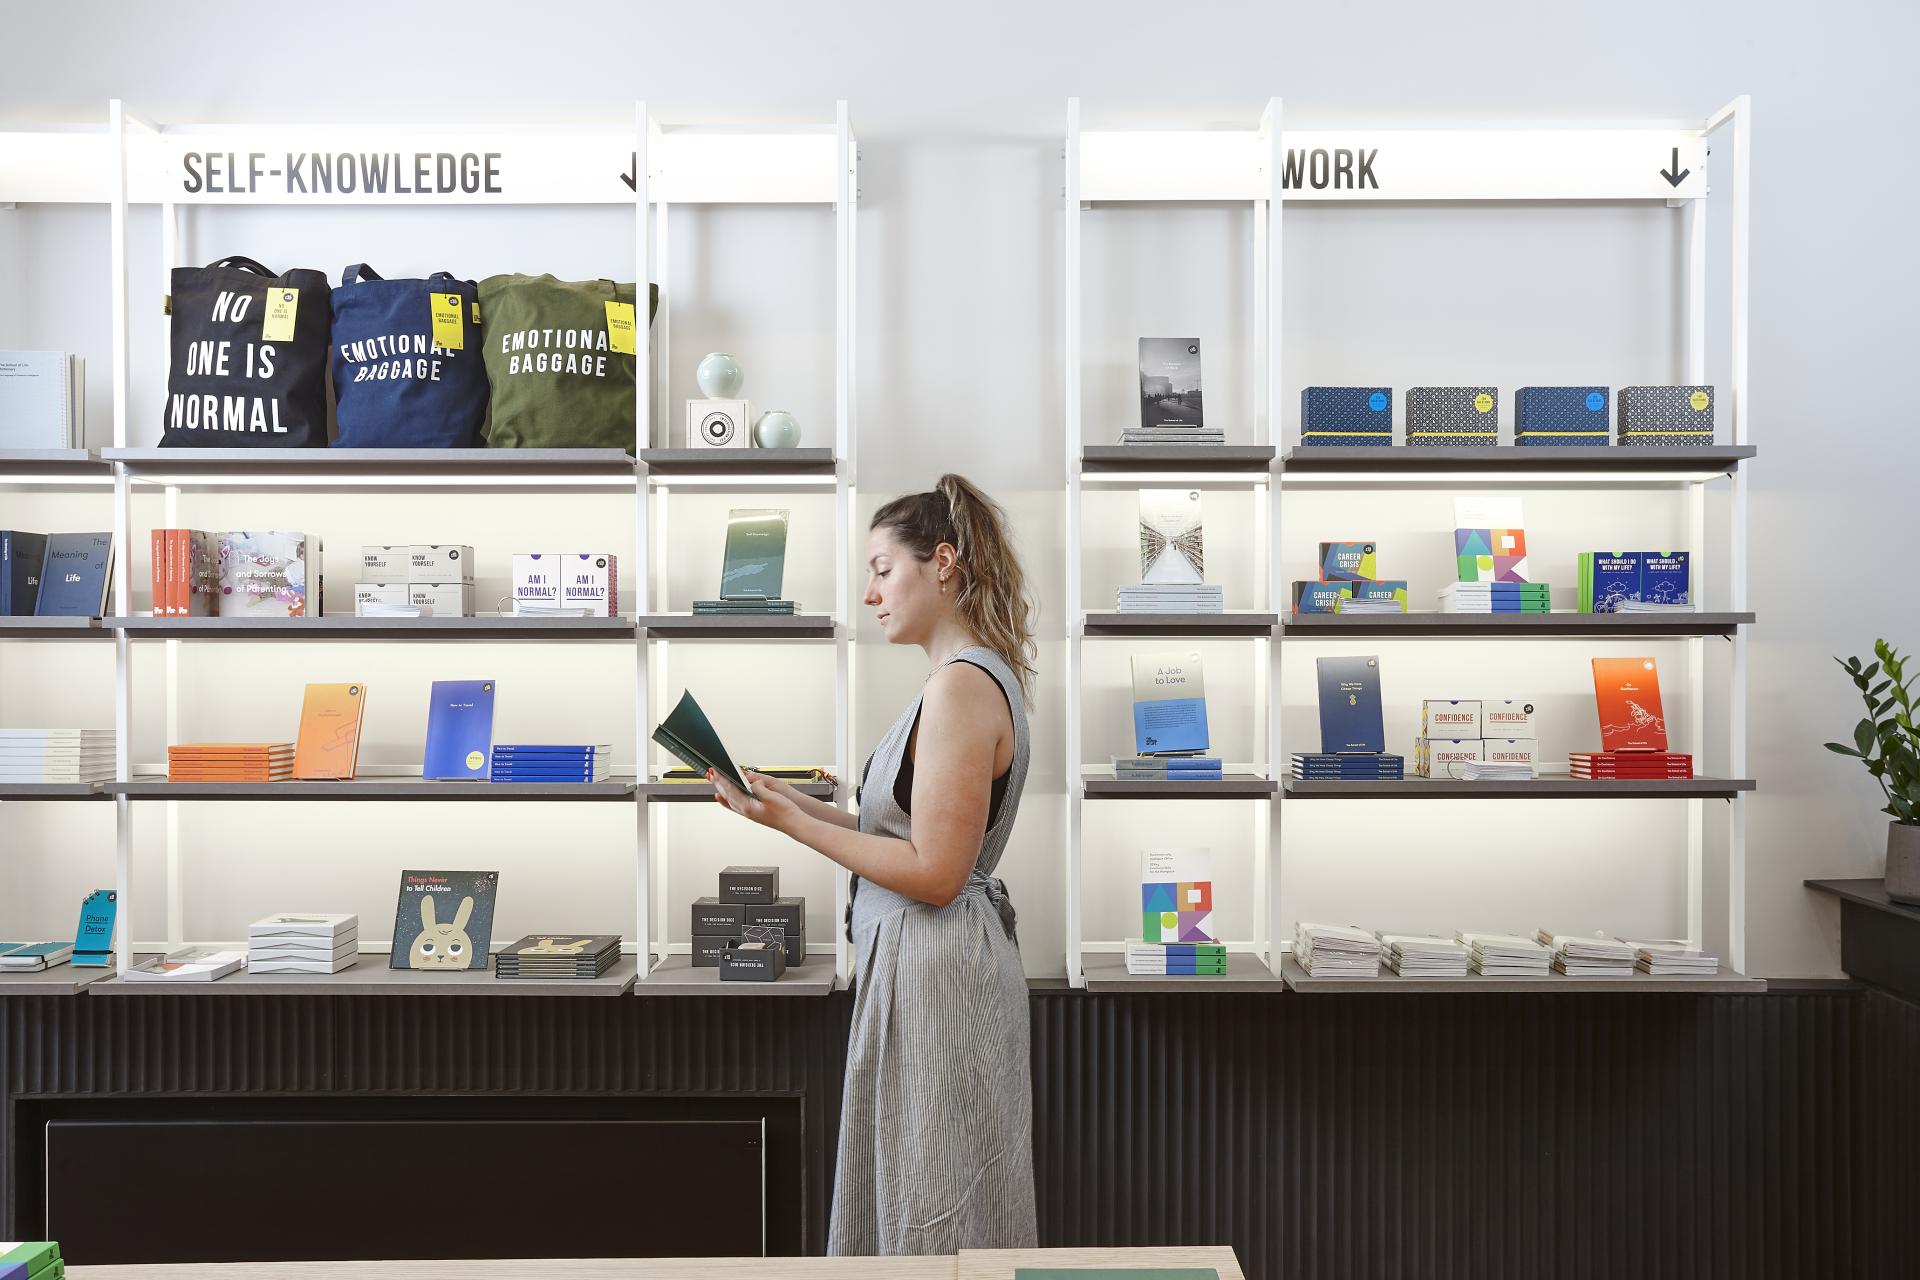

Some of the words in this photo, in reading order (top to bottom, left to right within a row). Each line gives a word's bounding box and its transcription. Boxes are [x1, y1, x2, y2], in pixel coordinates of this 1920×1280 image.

[183, 151, 502, 194] SELF-KNOWLEDGE
[1281, 148, 1379, 190] WORK
[211, 291, 253, 323] NO
[502, 329, 608, 354] EMOTIONA
[186, 340, 231, 376] ONE
[246, 343, 276, 379] IS
[508, 352, 607, 377] BAGGAGE
[353, 358, 442, 383] BAGGAGE
[170, 393, 288, 433] NORMAL
[93, 538, 107, 546] The
[52, 551, 88, 560] Meaning
[244, 555, 258, 563] The
[259, 555, 279, 565] Joys
[1337, 553, 1361, 561] CAREER
[95, 562, 104, 570] of
[65, 573, 81, 583] Life
[236, 570, 252, 578] and
[253, 570, 287, 578] Sorrows
[528, 574, 541, 585] AM
[576, 575, 589, 585] AM
[236, 585, 245, 593] of
[246, 585, 287, 595] Parenting
[517, 586, 557, 597] NORMAL?
[565, 587, 605, 597] NORMAL?
[1369, 591, 1392, 599] CAREER
[1157, 668, 1164, 676] A
[1165, 667, 1182, 675] Job
[1166, 676, 1186, 684] Love
[1435, 713, 1474, 722] CONFIDENCE
[1489, 712, 1528, 721] CONFIDENCE
[1437, 752, 1477, 761] CONFIDENCE
[1492, 752, 1532, 761] CONFIDENCE
[408, 875, 428, 885] Things
[428, 875, 448, 883] Never
[425, 884, 452, 892] Children
[86, 914, 109, 922] Phone
[85, 925, 105, 933] Detox
